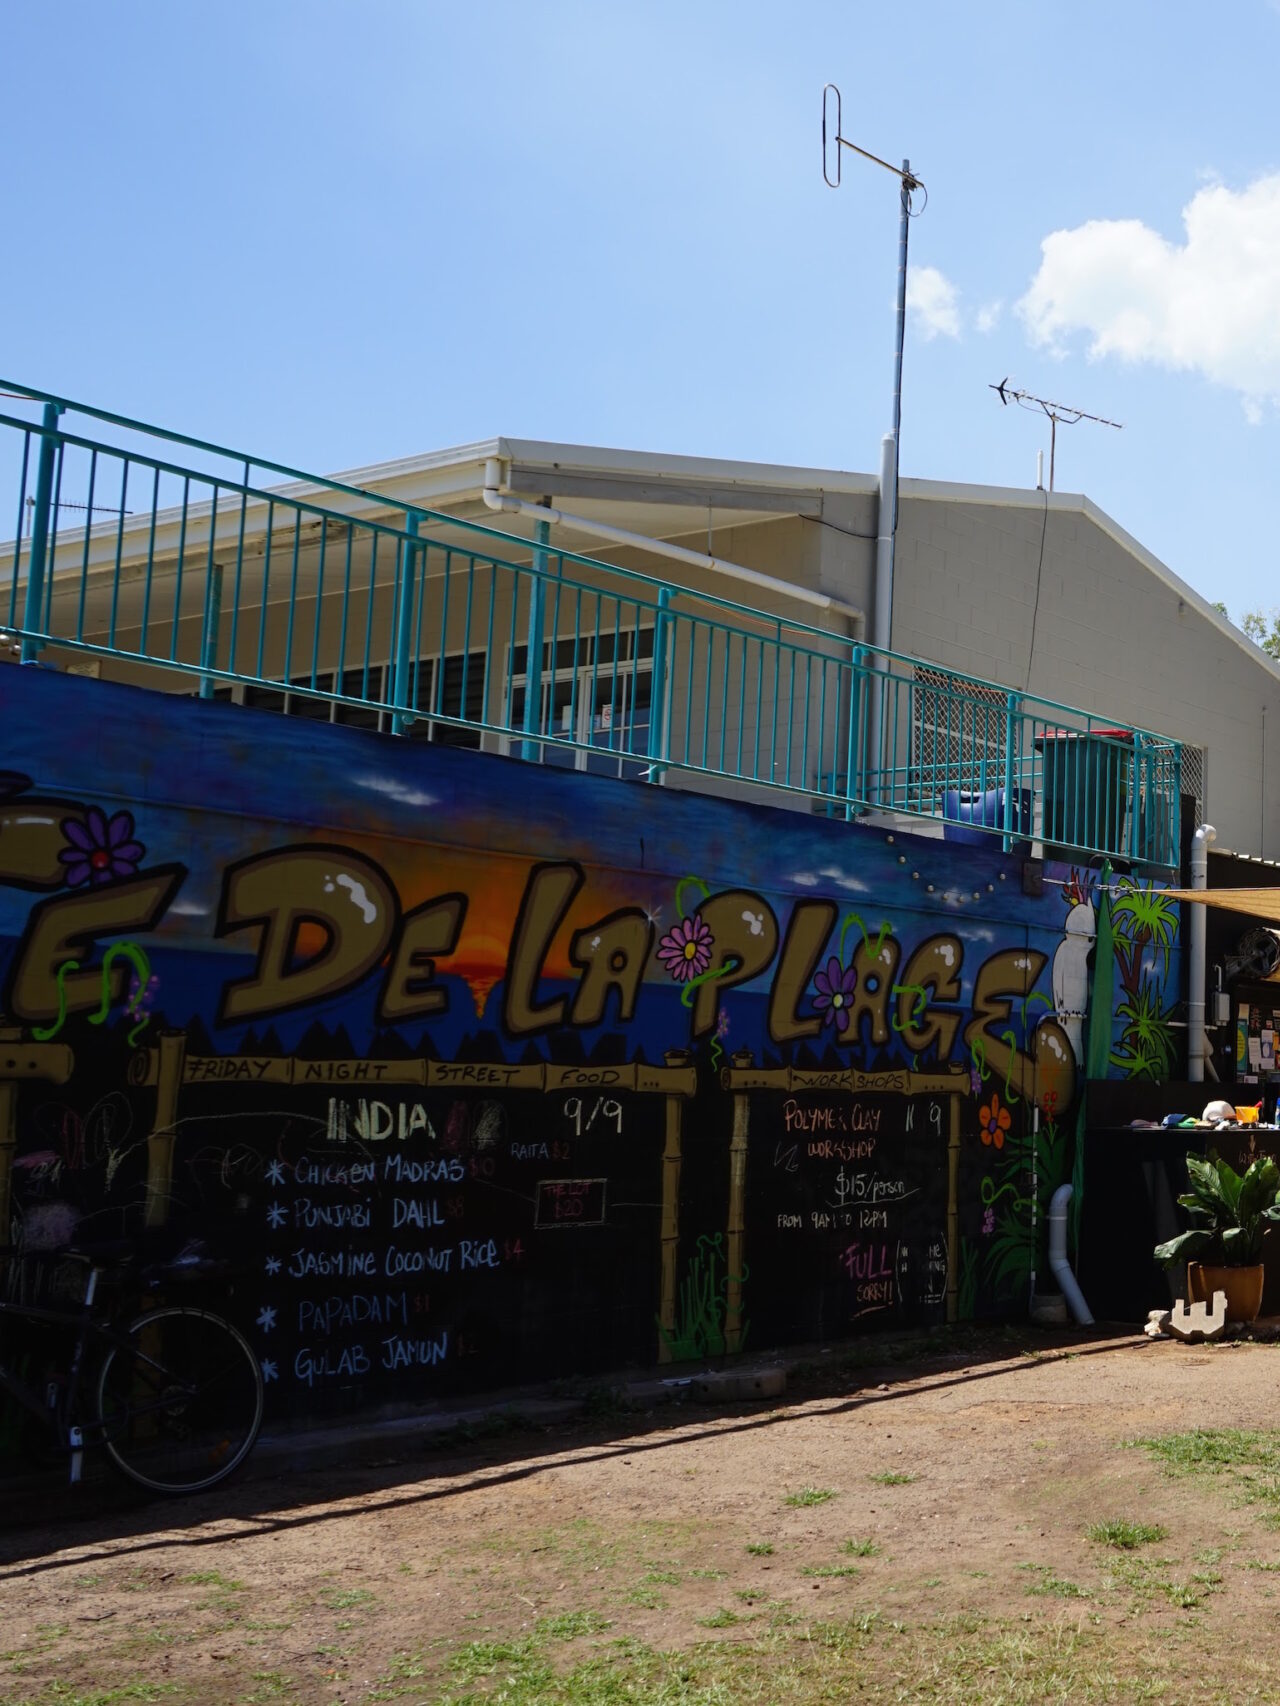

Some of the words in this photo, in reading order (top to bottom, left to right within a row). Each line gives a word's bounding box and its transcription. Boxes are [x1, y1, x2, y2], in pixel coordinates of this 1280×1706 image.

[690, 888, 1078, 1116] PLAGE
[305, 1062, 388, 1081] NIGHT
[436, 1064, 520, 1084] STREET
[561, 1069, 620, 1084] FOOD
[326, 1097, 437, 1142] INDIA
[563, 1096, 623, 1136] 9/9
[851, 1103, 881, 1132] CLAY
[510, 1142, 549, 1161] RAITA
[392, 1198, 446, 1229] DAHL
[777, 1213, 803, 1229] FROM
[859, 1210, 888, 1230] 12PM
[385, 1245, 453, 1277] COCONUT
[842, 1241, 893, 1281] FULL
[856, 1281, 894, 1306] SORRY!
[298, 1291, 409, 1336] PAPADAM
[380, 1331, 448, 1371] JAMUN
